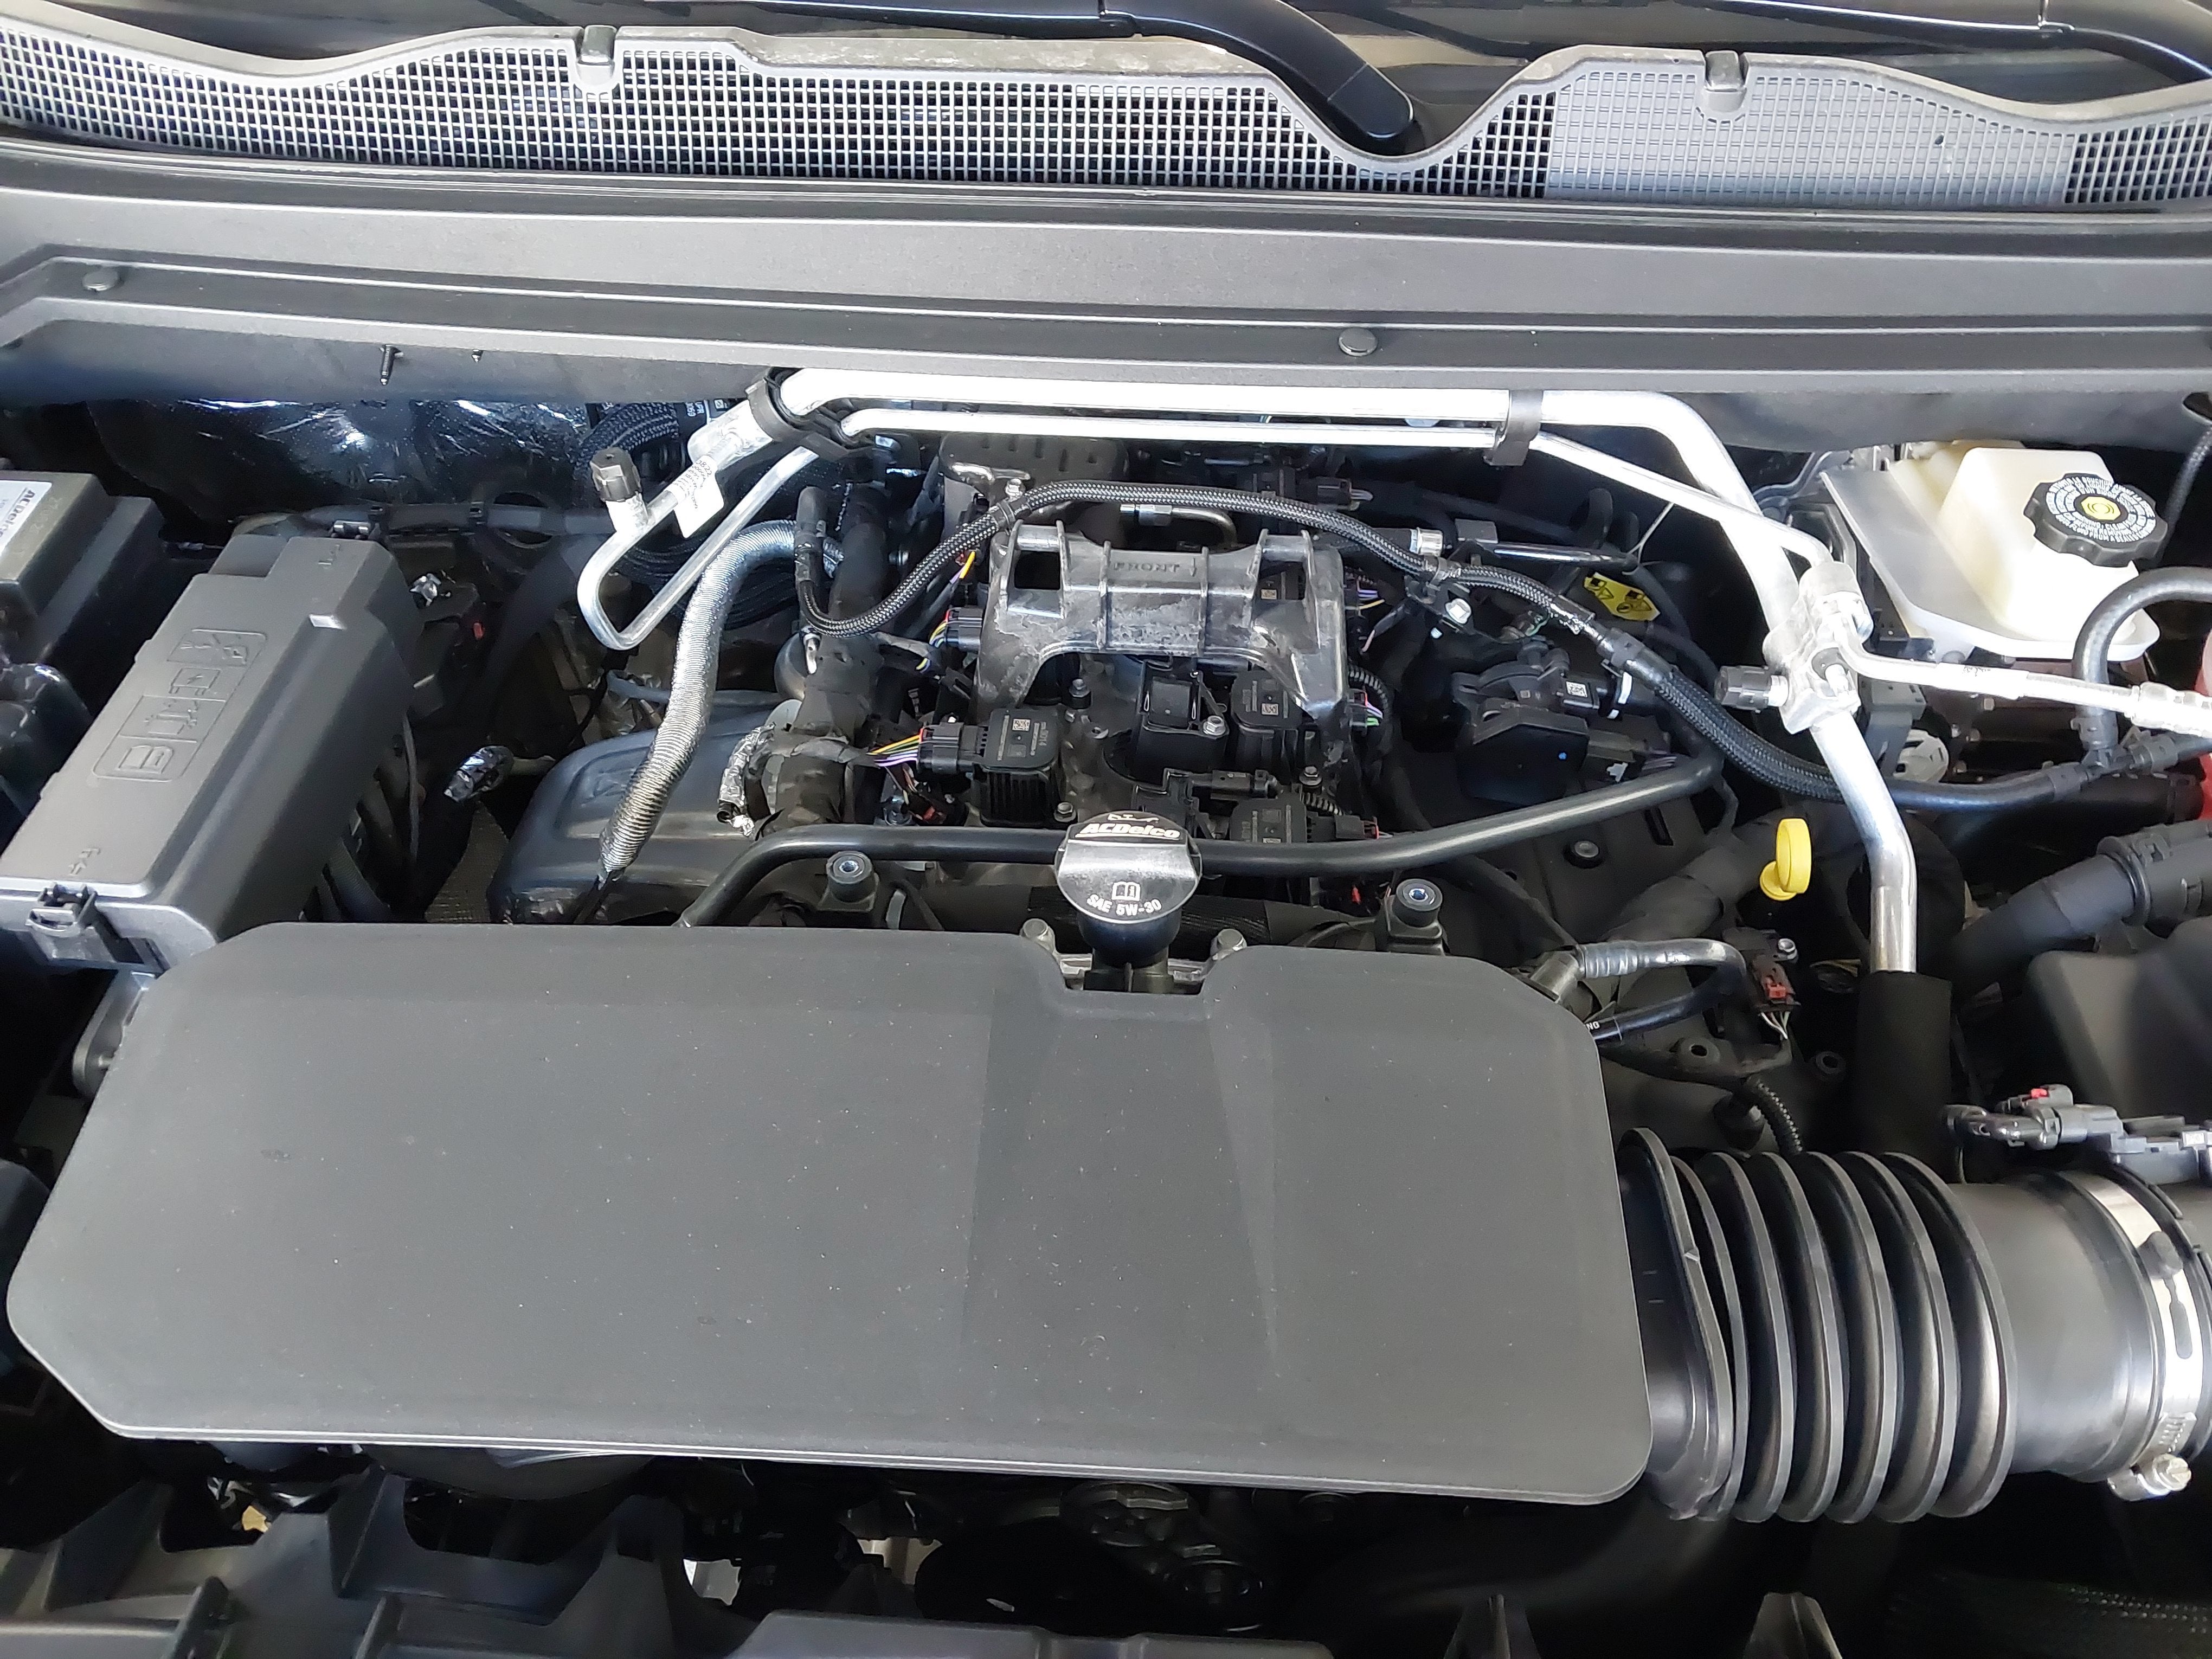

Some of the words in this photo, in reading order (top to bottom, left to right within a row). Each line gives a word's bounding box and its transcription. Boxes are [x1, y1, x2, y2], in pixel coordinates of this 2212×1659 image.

[1114, 562, 1180, 573] FRONT
[1079, 823, 1180, 838] ACDelco
[1086, 894, 1113, 913] SAE
[1116, 899, 1162, 916] 5W-30
